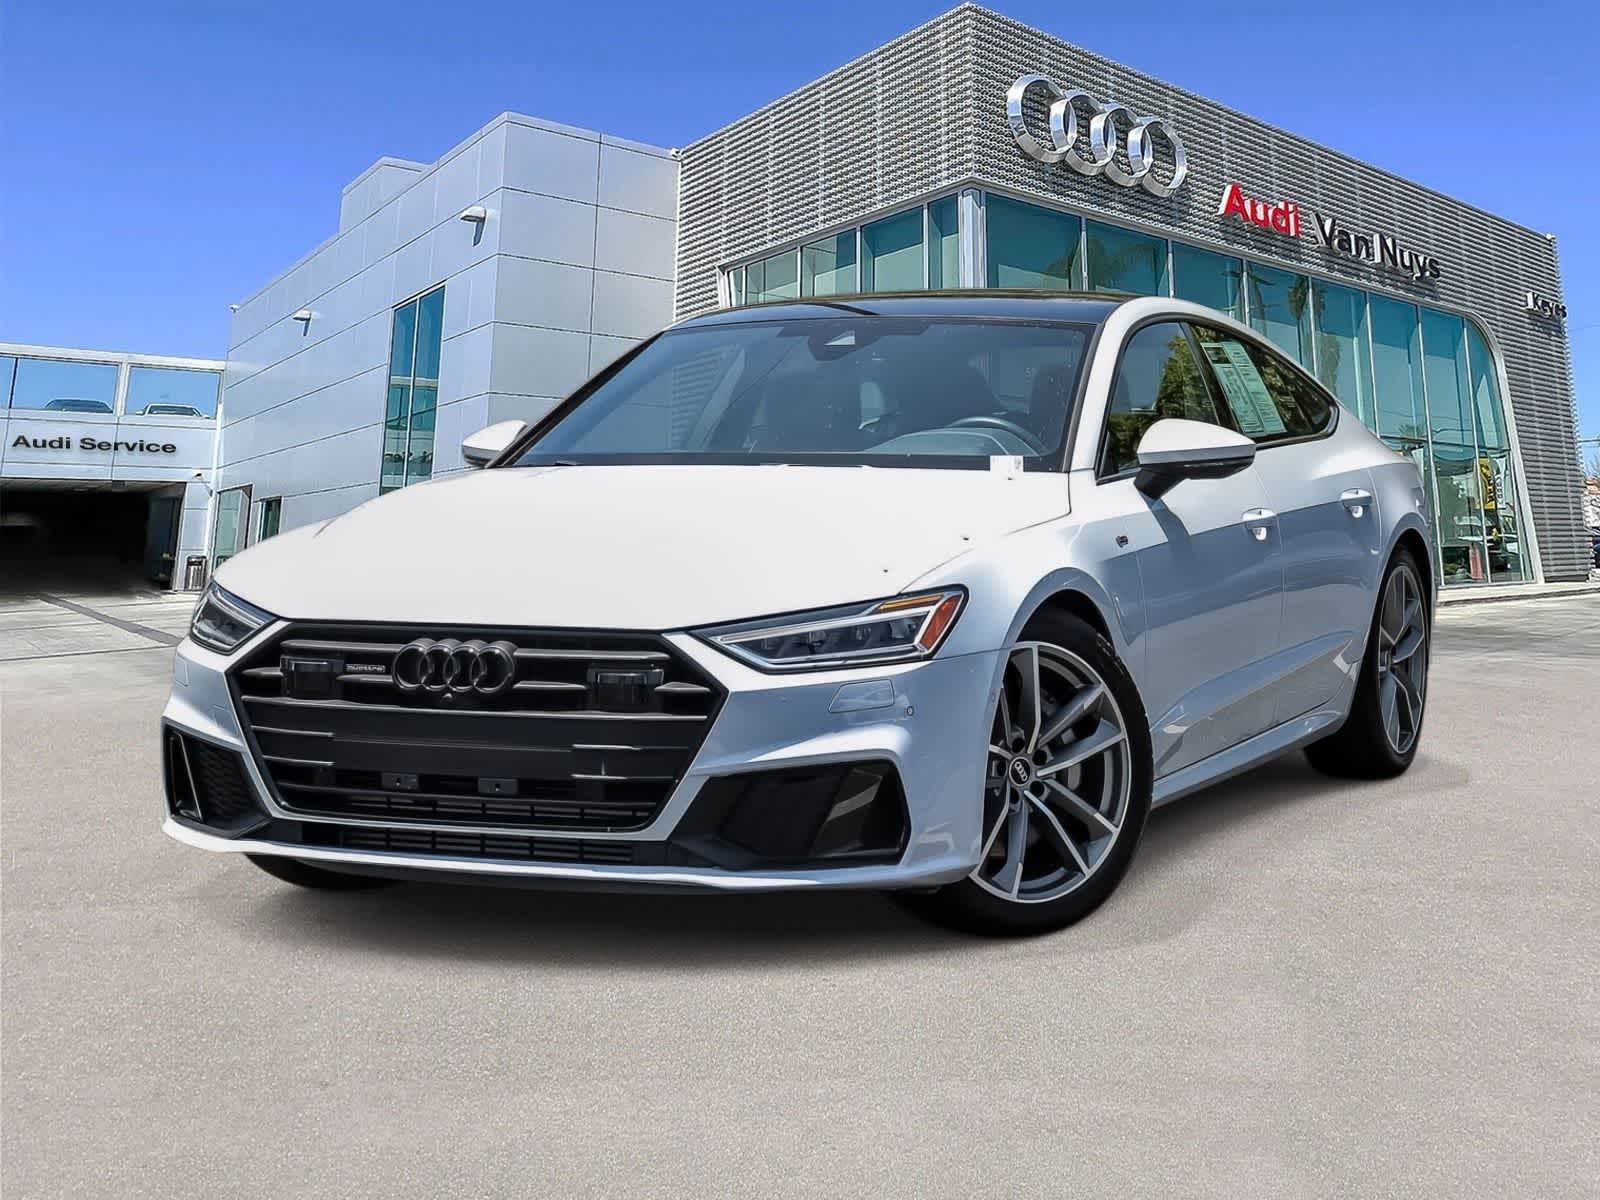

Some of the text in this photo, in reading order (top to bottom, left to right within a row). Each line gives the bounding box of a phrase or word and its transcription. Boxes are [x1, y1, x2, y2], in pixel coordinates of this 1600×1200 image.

[1219, 183, 1440, 280] Audi Van Nuys
[12, 435, 178, 453] Audi Service
